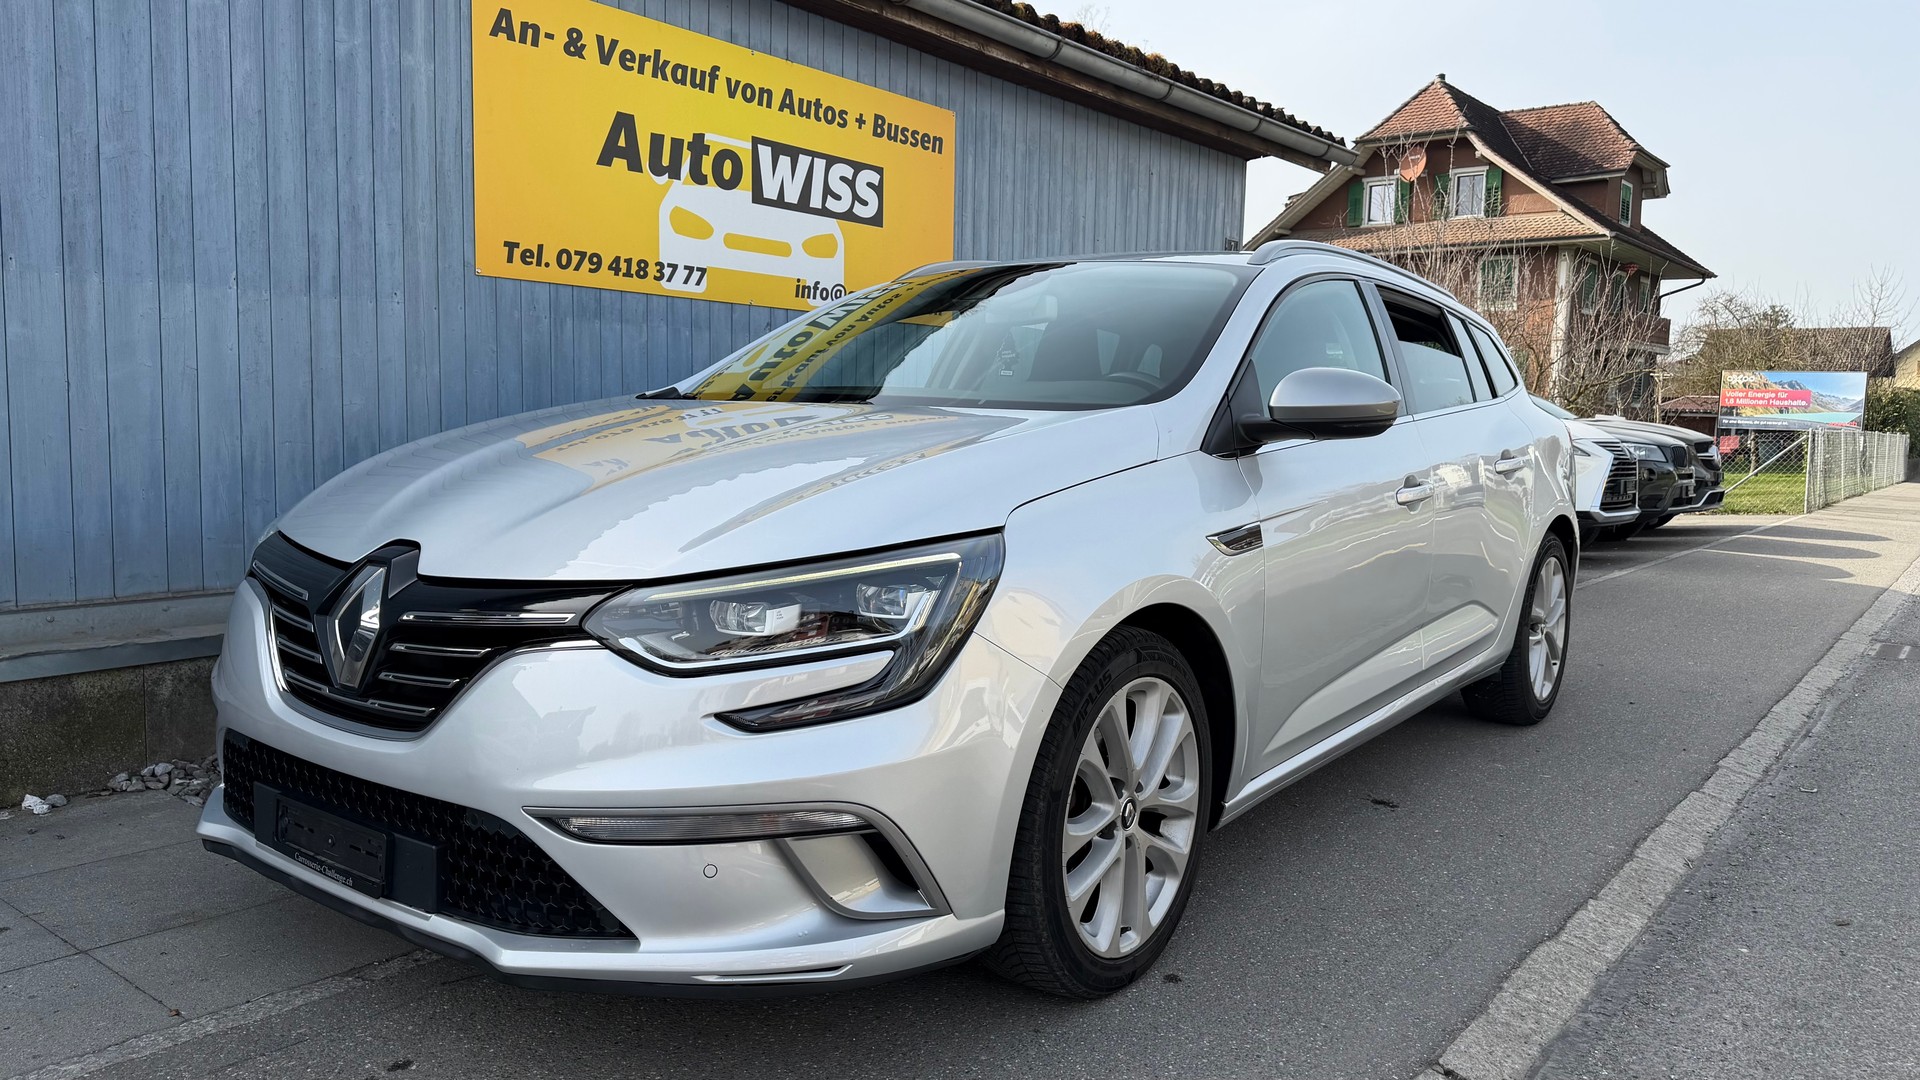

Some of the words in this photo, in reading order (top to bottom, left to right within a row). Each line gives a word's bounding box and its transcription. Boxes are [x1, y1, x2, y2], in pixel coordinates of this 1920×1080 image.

[489, 7, 555, 48] An-
[562, 27, 588, 60] &
[595, 33, 720, 95] Verkauf
[725, 75, 774, 109] von
[777, 88, 848, 129] Autos
[854, 112, 867, 131] +
[872, 113, 945, 155] Bussen
[503, 240, 551, 269] Tel.
[556, 246, 602, 275] 079
[607, 255, 650, 281] 418
[653, 261, 679, 284] 37
[682, 264, 708, 288] 77
